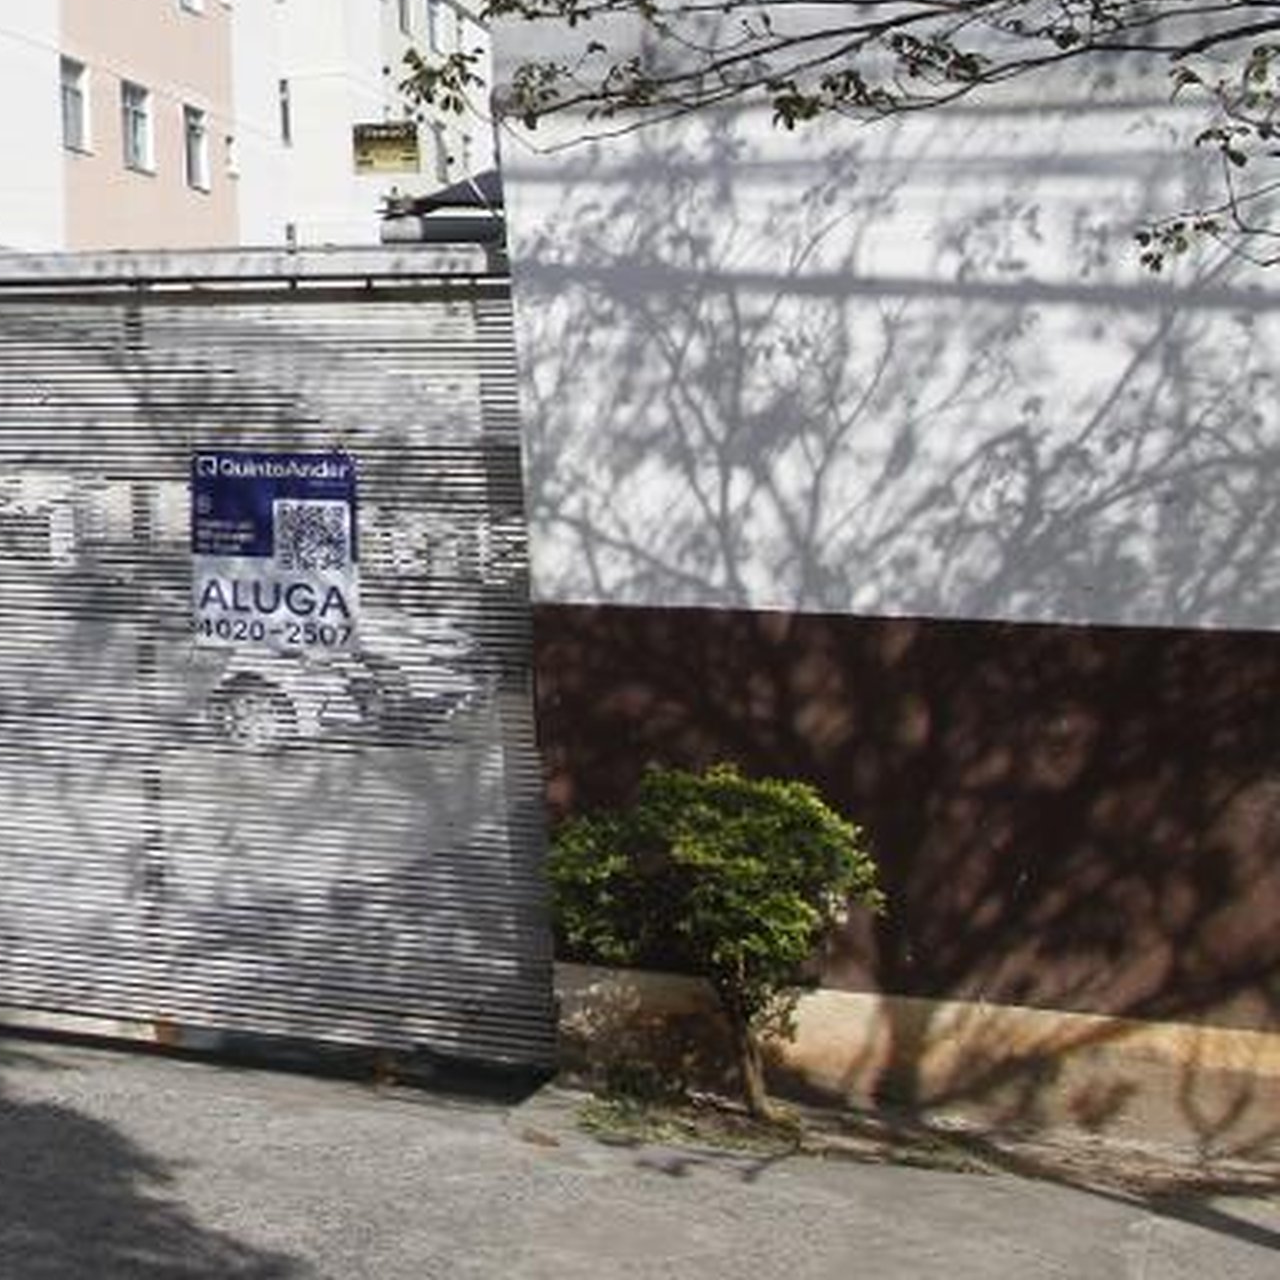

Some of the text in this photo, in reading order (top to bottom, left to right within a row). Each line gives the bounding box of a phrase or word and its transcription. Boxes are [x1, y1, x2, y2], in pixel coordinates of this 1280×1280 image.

[220, 458, 350, 479] QuintoAndar
[199, 578, 352, 619] ALUGA
[199, 618, 353, 647] 4020-2507
